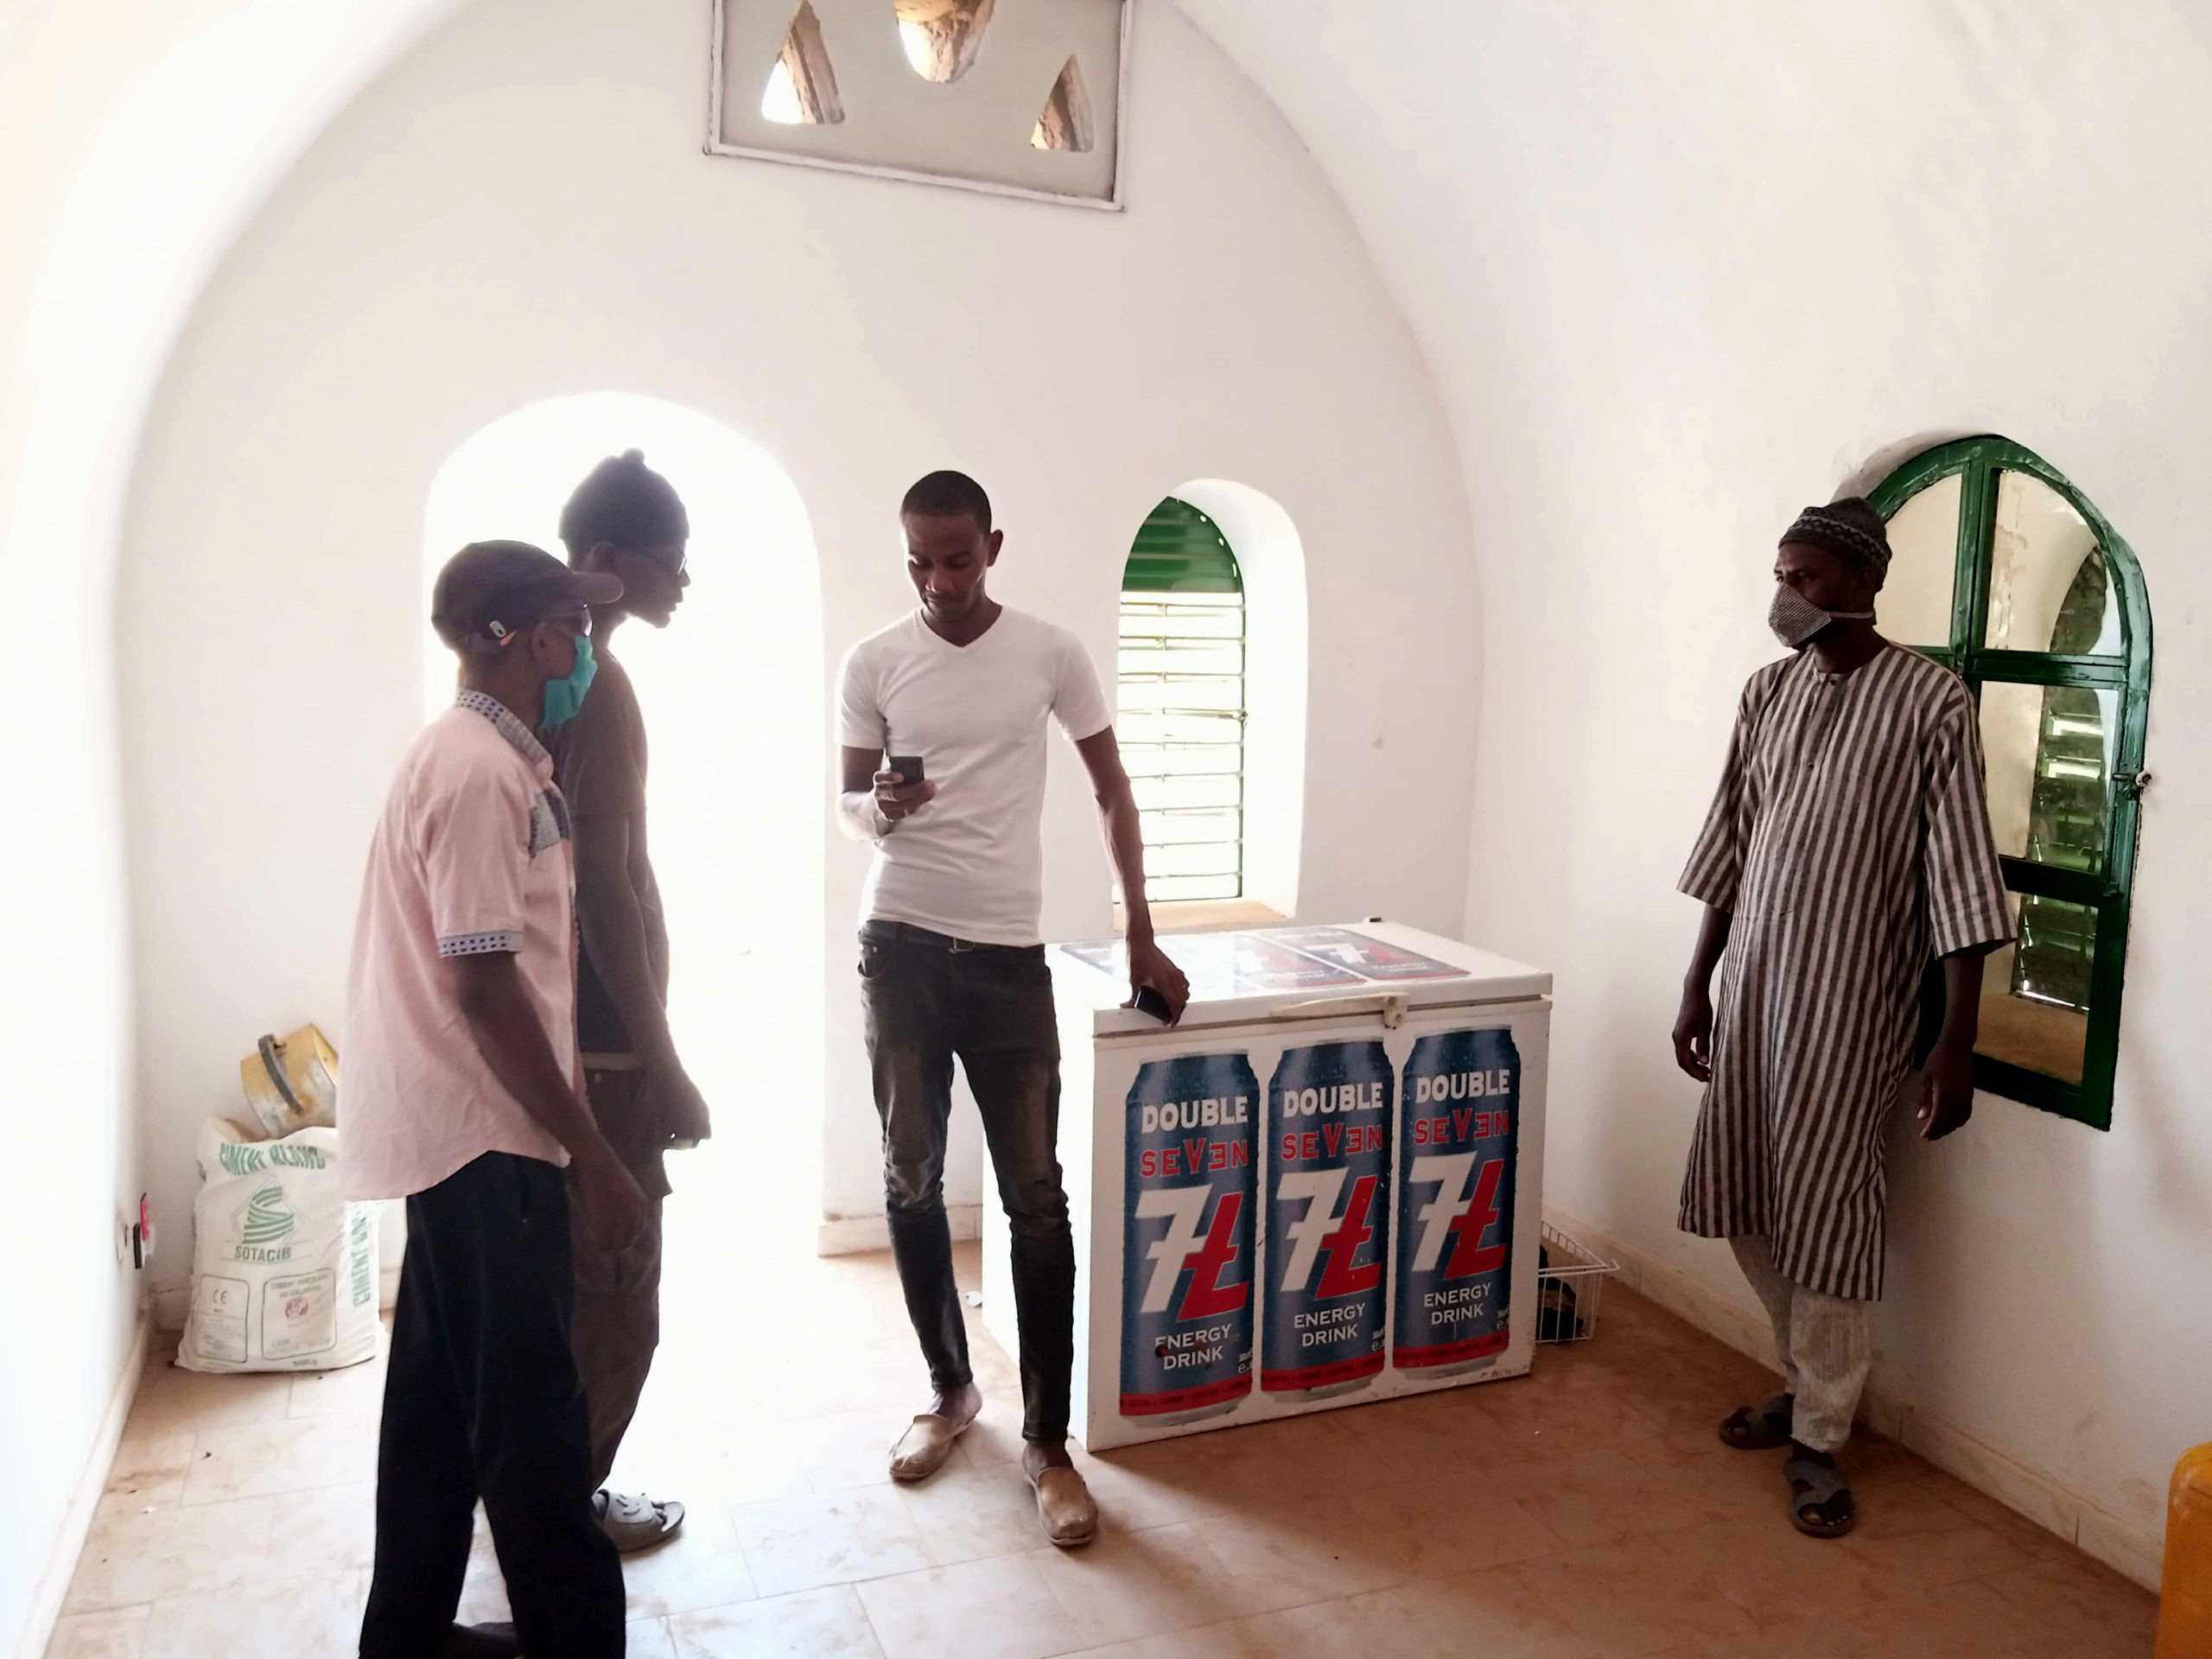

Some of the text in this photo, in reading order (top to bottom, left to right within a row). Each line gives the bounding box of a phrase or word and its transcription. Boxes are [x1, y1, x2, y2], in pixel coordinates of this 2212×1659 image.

[1283, 1082, 1382, 1118] DOUBLE
[1415, 1069, 1510, 1104] DOUBLE
[1141, 1096, 1248, 1135] DOUBLE
[1414, 1108, 1510, 1145] SEVEN
[1281, 1122, 1382, 1160] SEVEN
[1140, 1137, 1249, 1178] SEVEN
[235, 1244, 291, 1262] SOTACIB
[1424, 1282, 1491, 1307] ENERGY
[1294, 1302, 1365, 1329] ENERGY
[1431, 1303, 1488, 1325] DRINK
[1155, 1324, 1231, 1350] ENERGY
[1302, 1324, 1358, 1347] DRINK
[1164, 1345, 1224, 1370] DRINK
